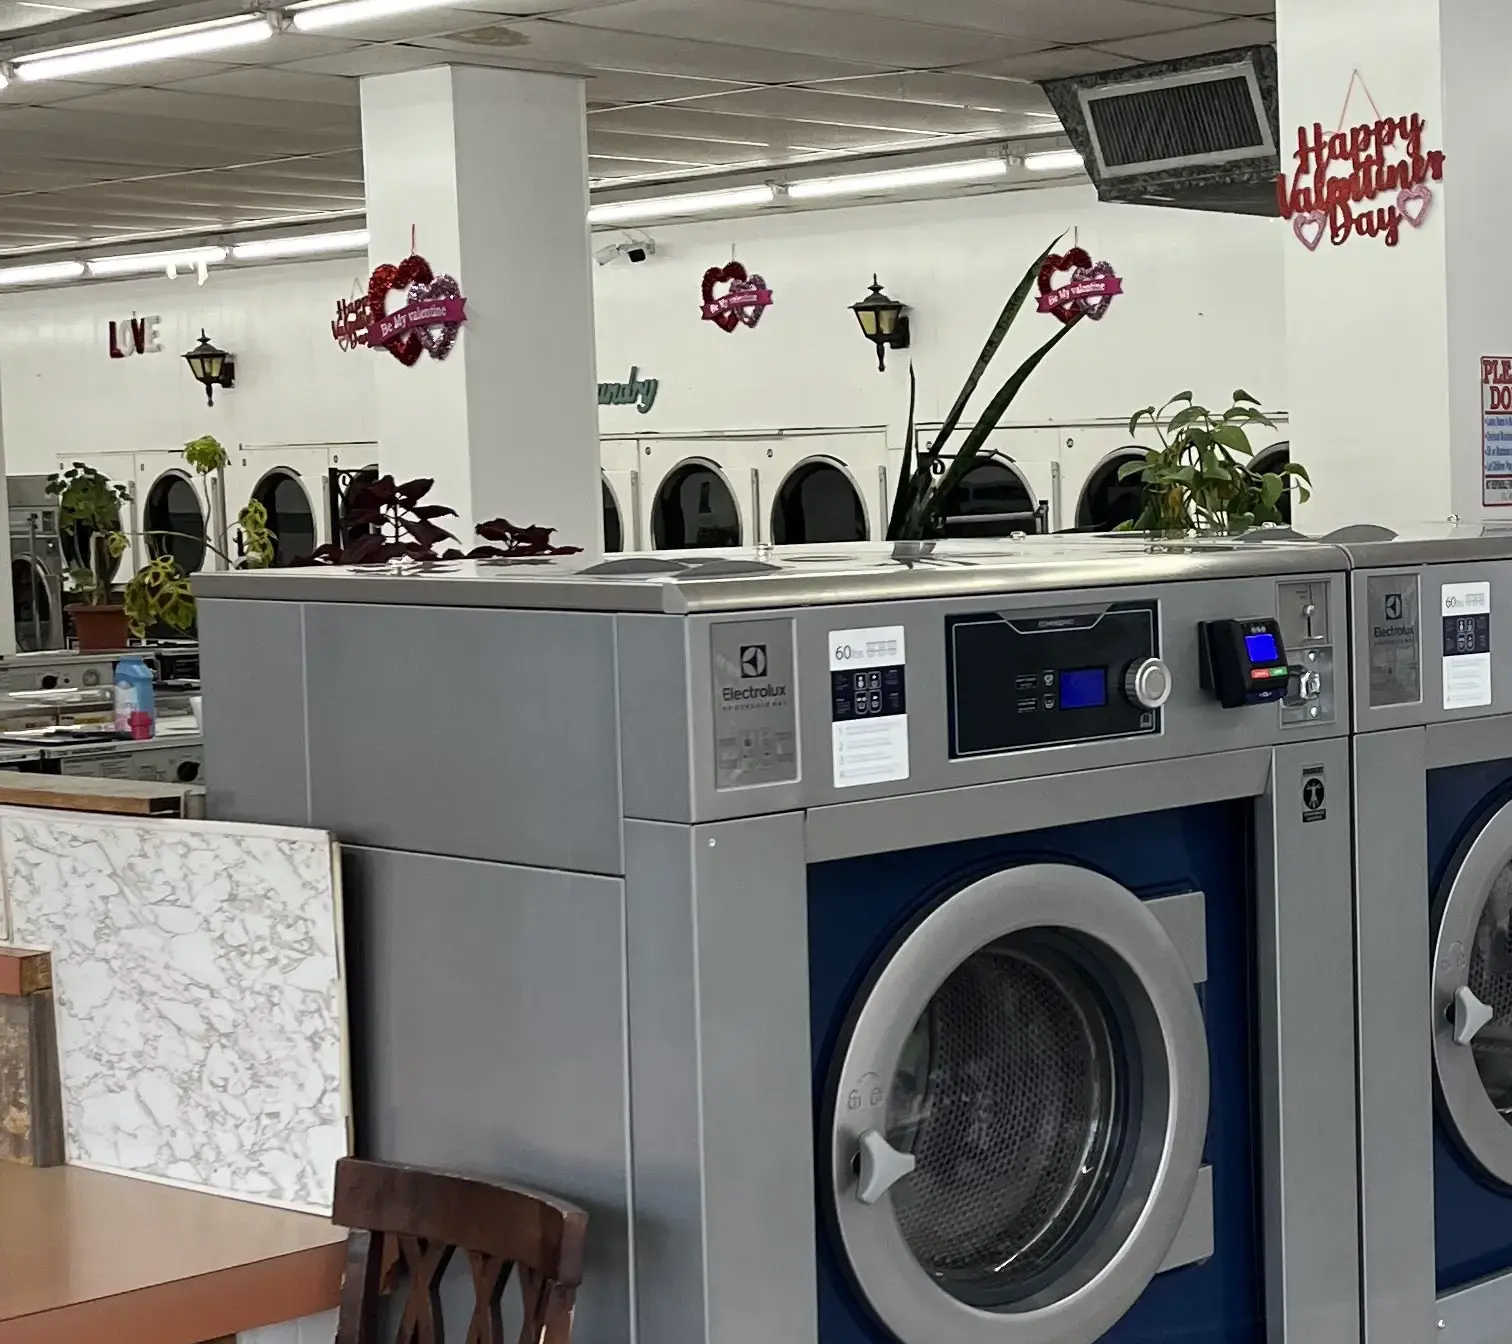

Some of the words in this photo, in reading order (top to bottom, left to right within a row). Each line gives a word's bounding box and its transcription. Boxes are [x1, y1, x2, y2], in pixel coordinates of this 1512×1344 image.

[1293, 113, 1426, 174] Happy
[1329, 204, 1403, 246] Day
[109, 316, 161, 358] LOVE
[380, 322, 393, 337] Be
[393, 314, 407, 331] My
[408, 304, 447, 321] valentine
[1374, 625, 1415, 639] Electrolux
[722, 684, 786, 702] Electrolux
